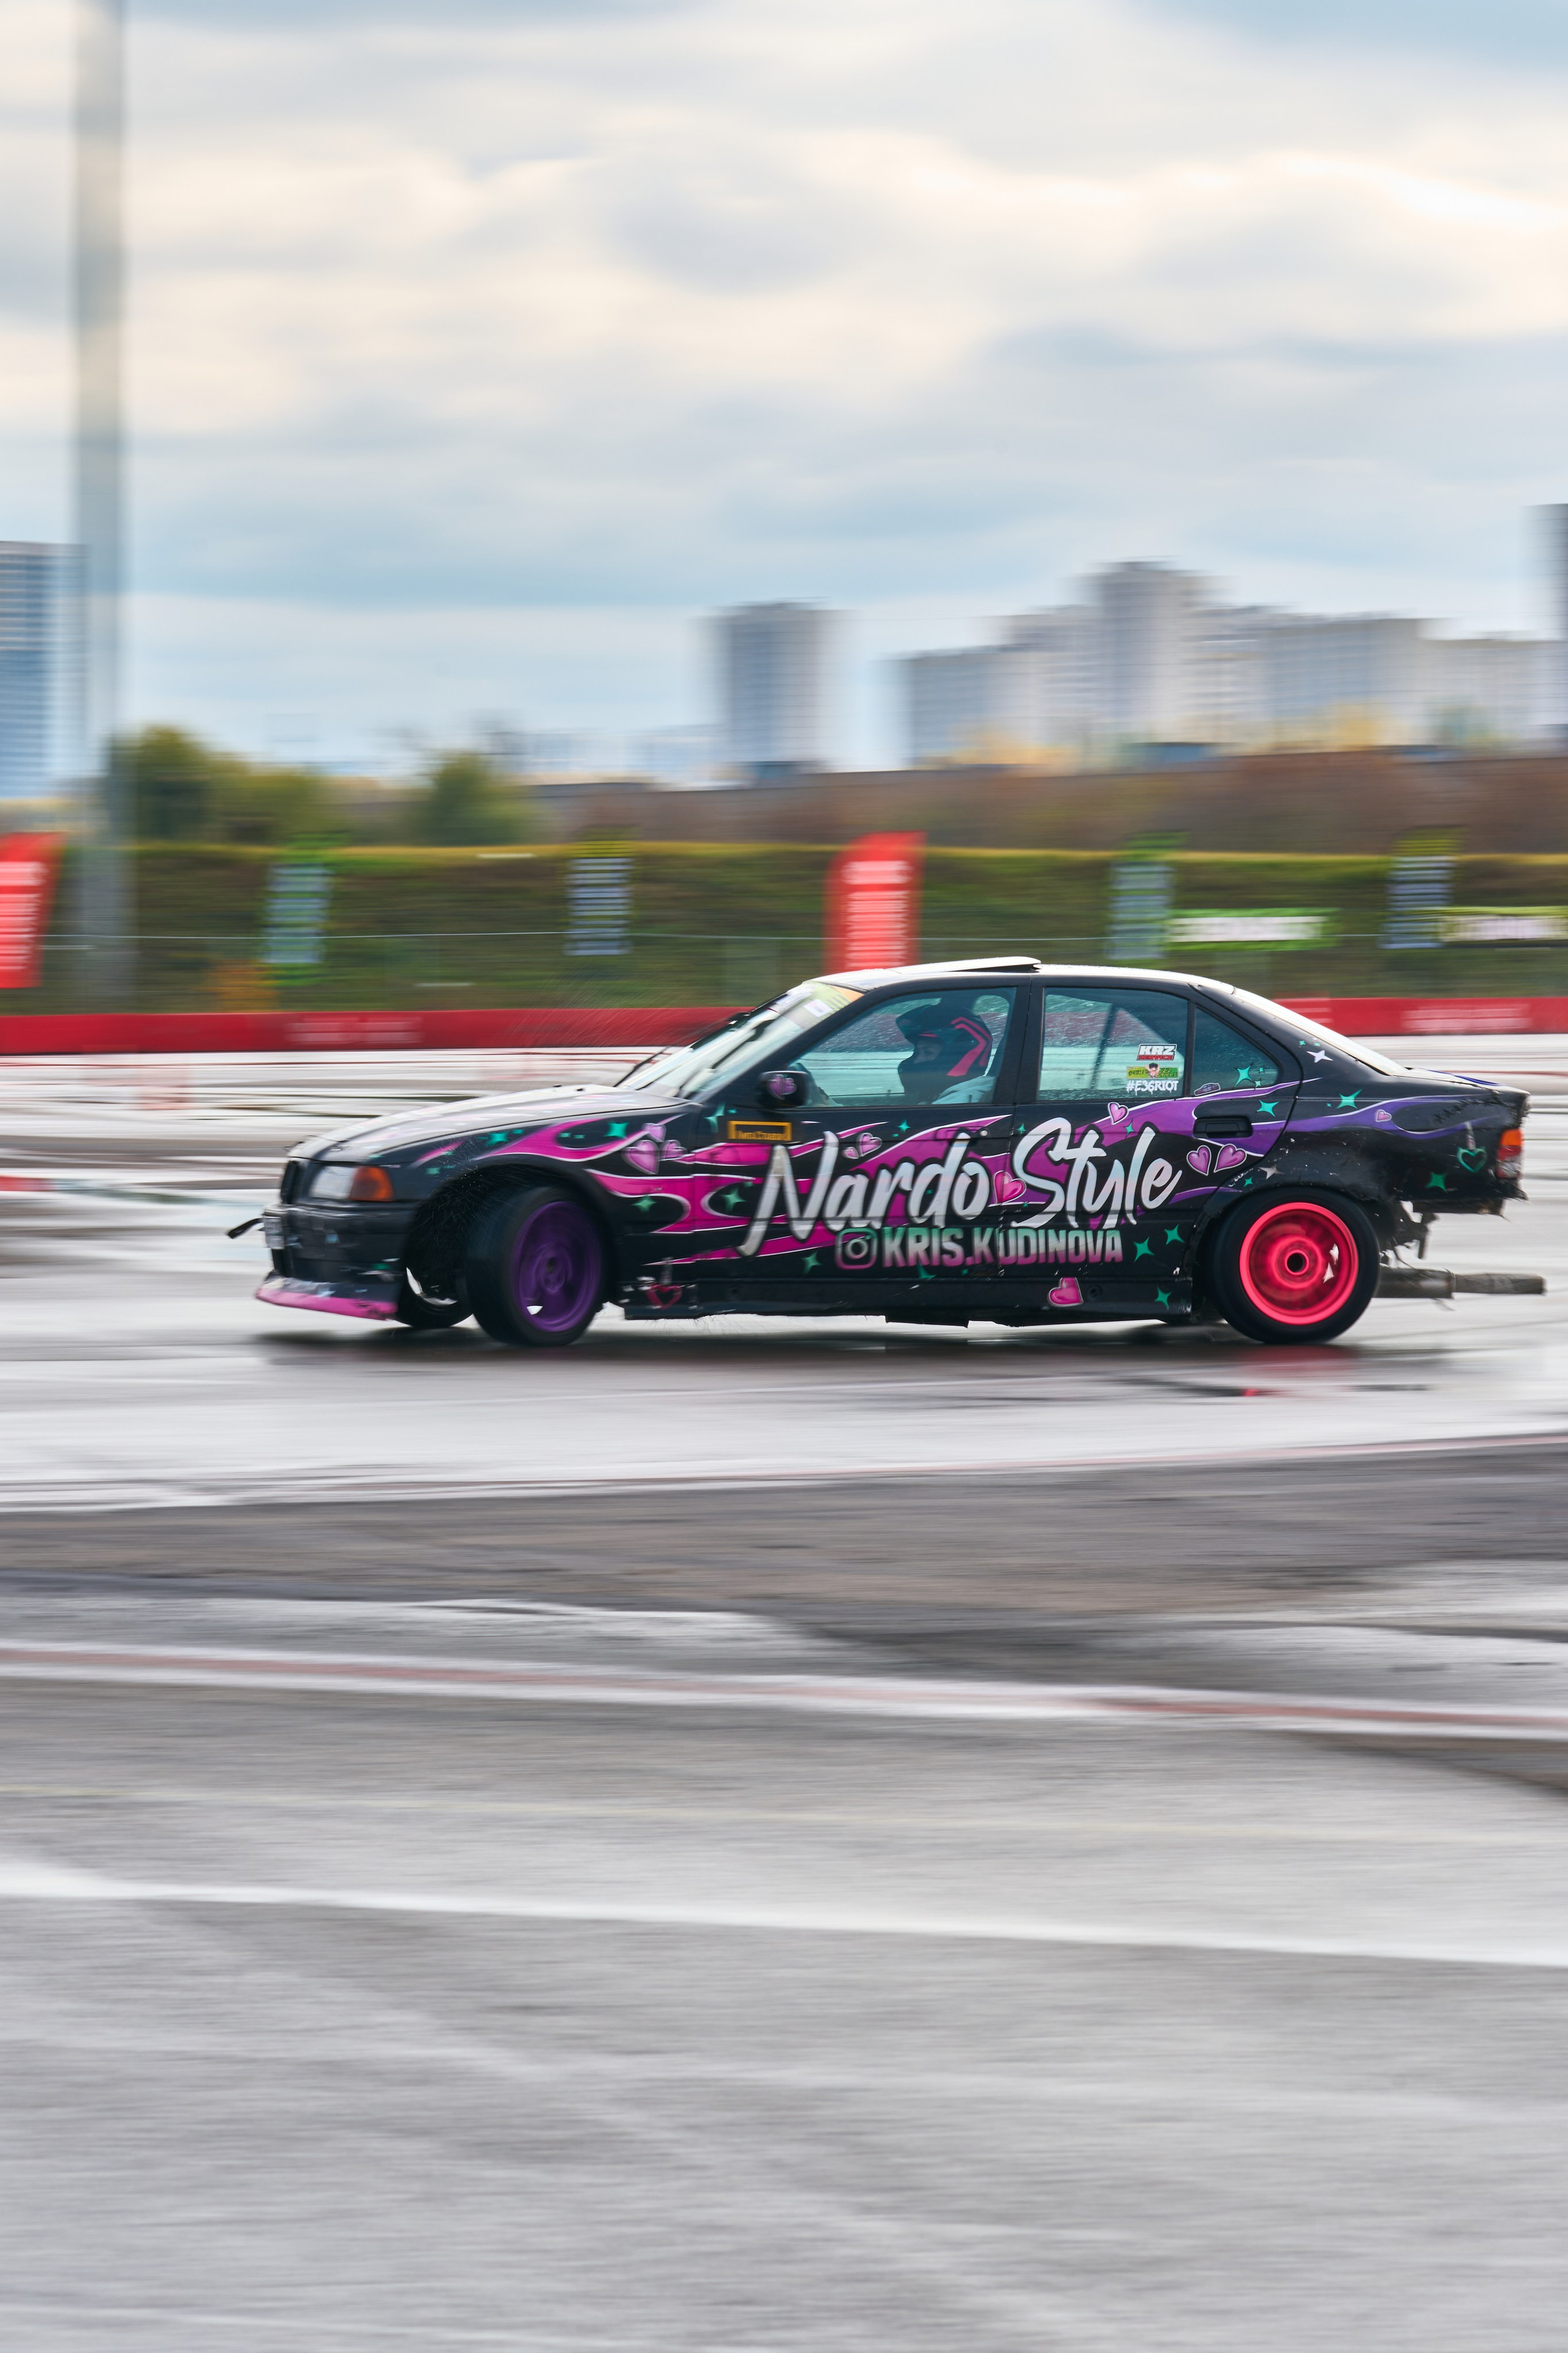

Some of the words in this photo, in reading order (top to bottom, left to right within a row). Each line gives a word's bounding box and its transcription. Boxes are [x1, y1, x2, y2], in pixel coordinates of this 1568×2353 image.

[1139, 1045, 1175, 1055] KRZ
[1126, 1080, 1179, 1095] #E36RIOT
[737, 1131, 990, 1256] Nardo
[1011, 1117, 1182, 1229] Style
[883, 1226, 1123, 1267] KRIS.KUDINOVA
